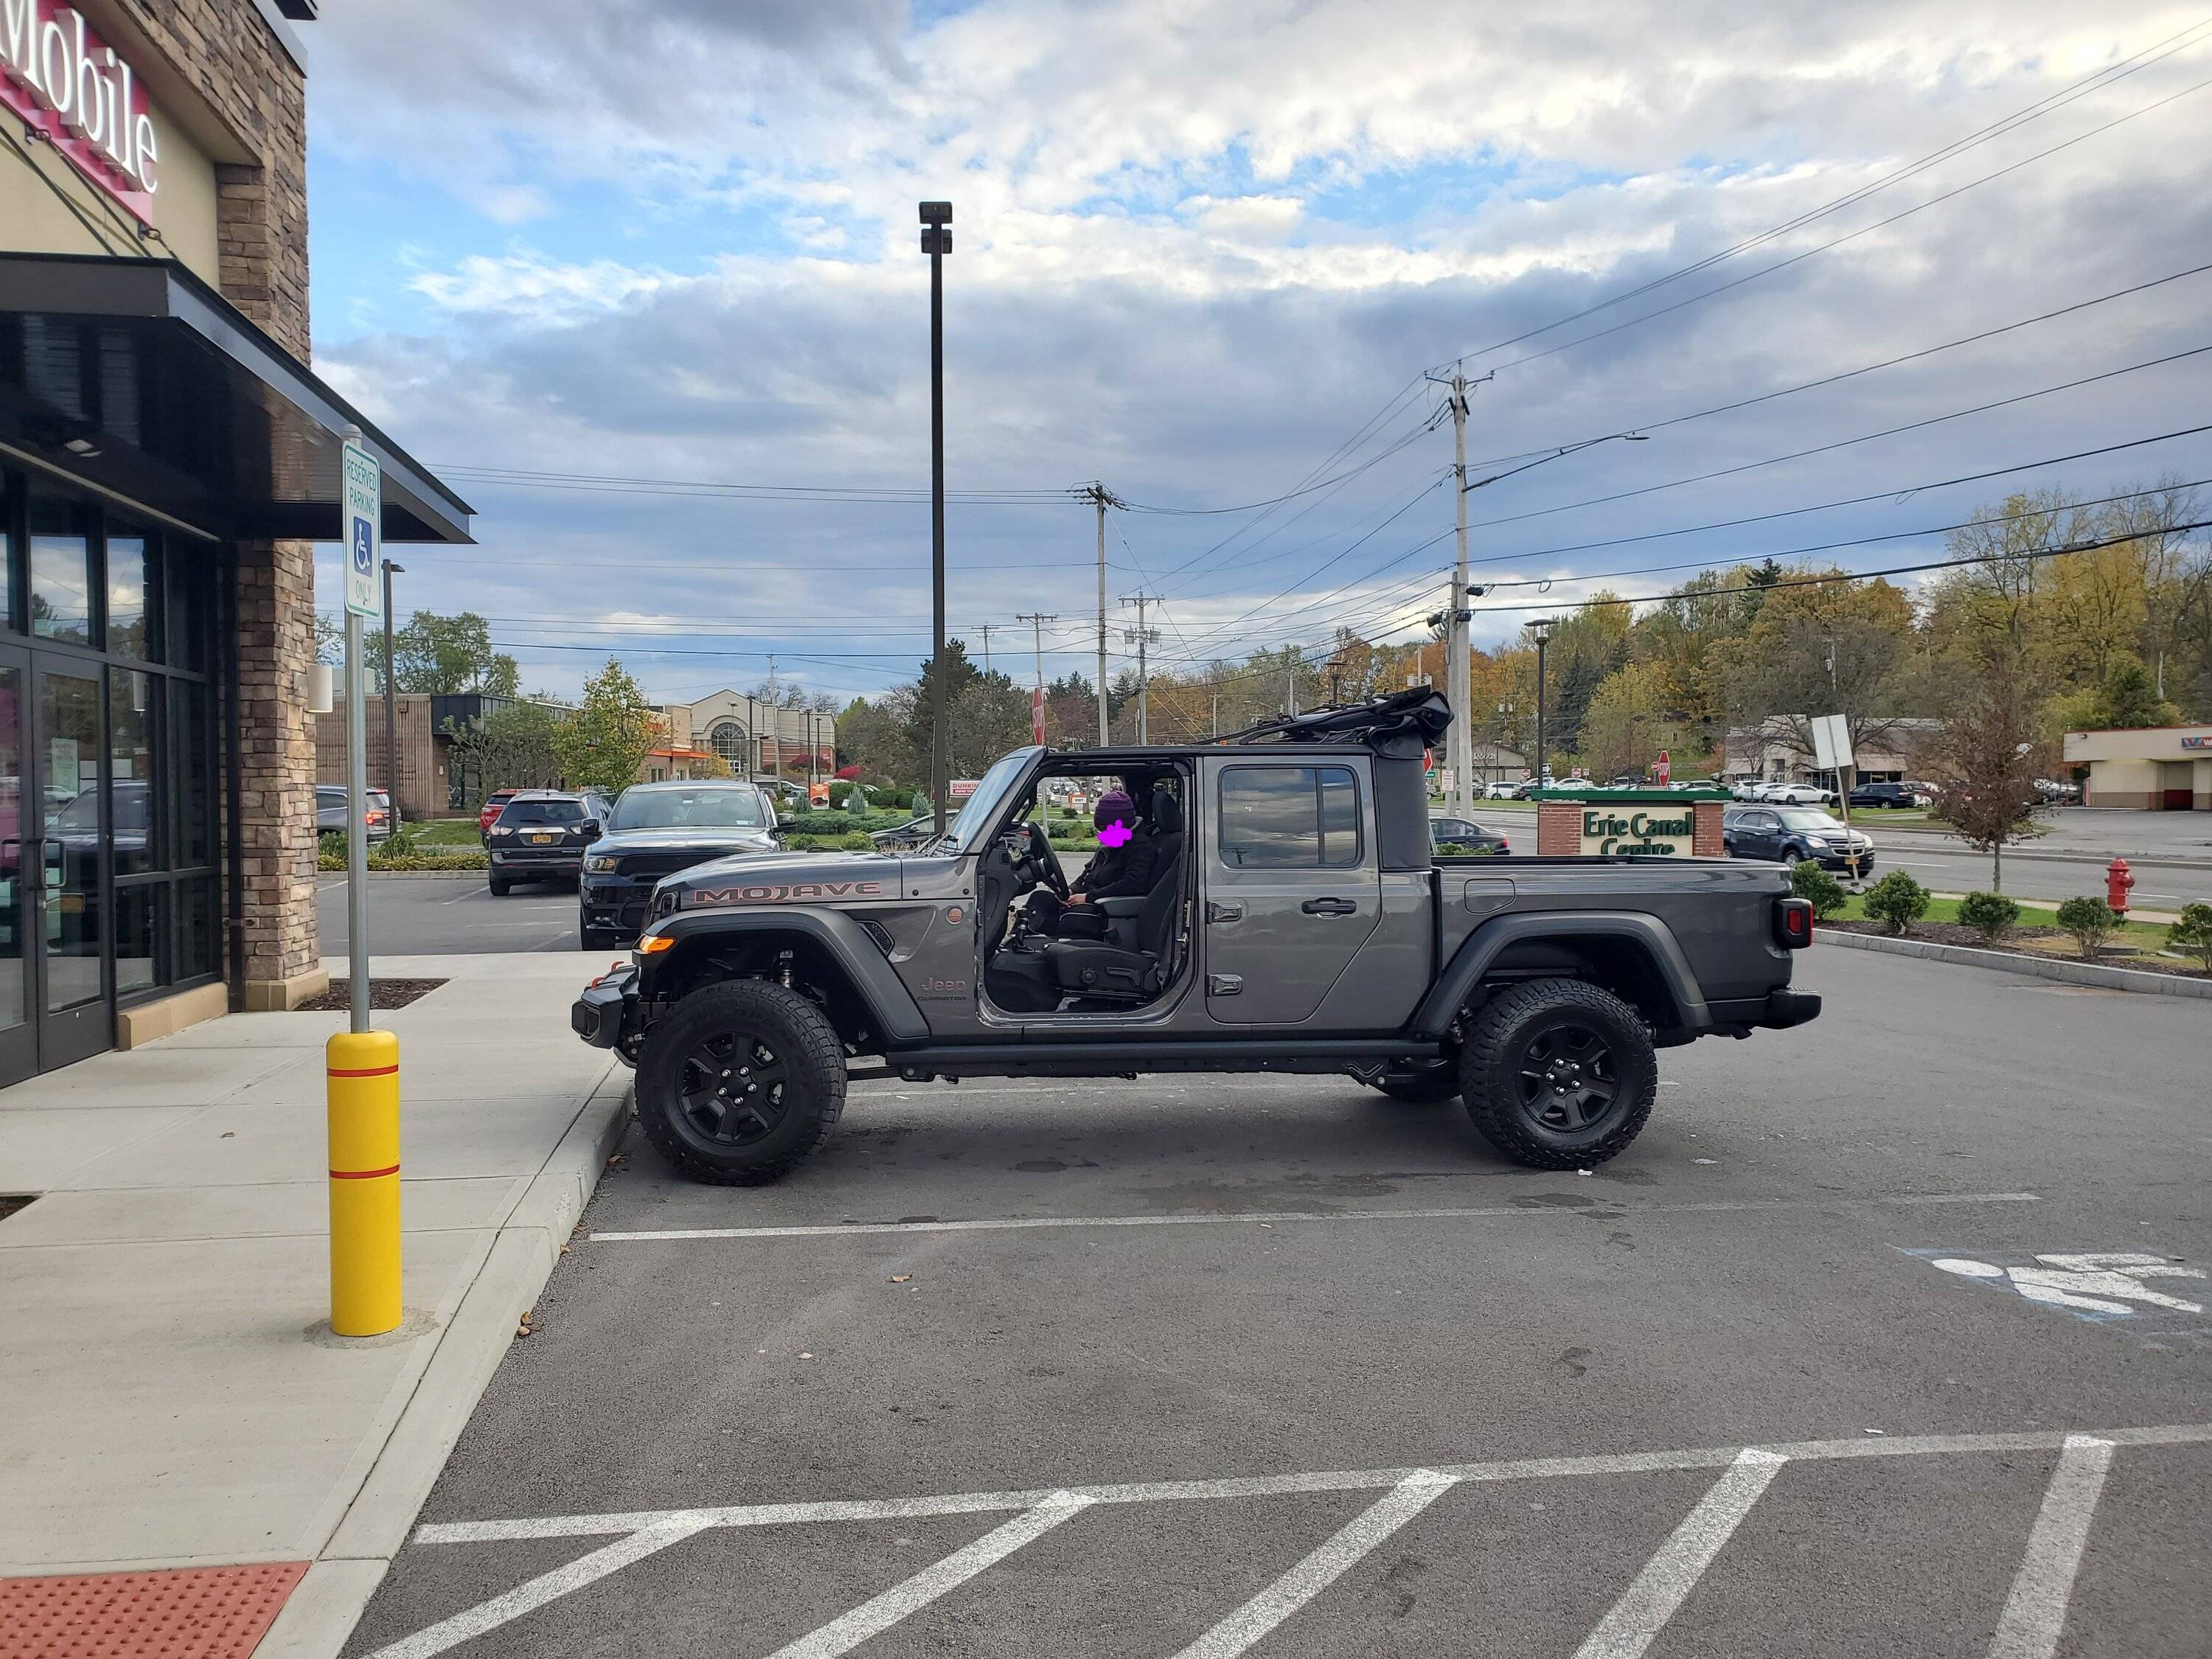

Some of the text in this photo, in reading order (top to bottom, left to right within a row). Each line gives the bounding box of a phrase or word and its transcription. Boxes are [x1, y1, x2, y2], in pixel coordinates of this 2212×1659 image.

[0, 0, 157, 193] Mobile
[347, 459, 376, 492] RESERVED
[350, 487, 374, 516] PARKING
[355, 580, 372, 602] ONLY
[1033, 705, 1043, 728] STOP
[1659, 762, 1669, 776] STOP
[1584, 811, 1693, 838] Erie Canal
[695, 881, 882, 902] MOJAVE
[921, 977, 968, 992] Jeep
